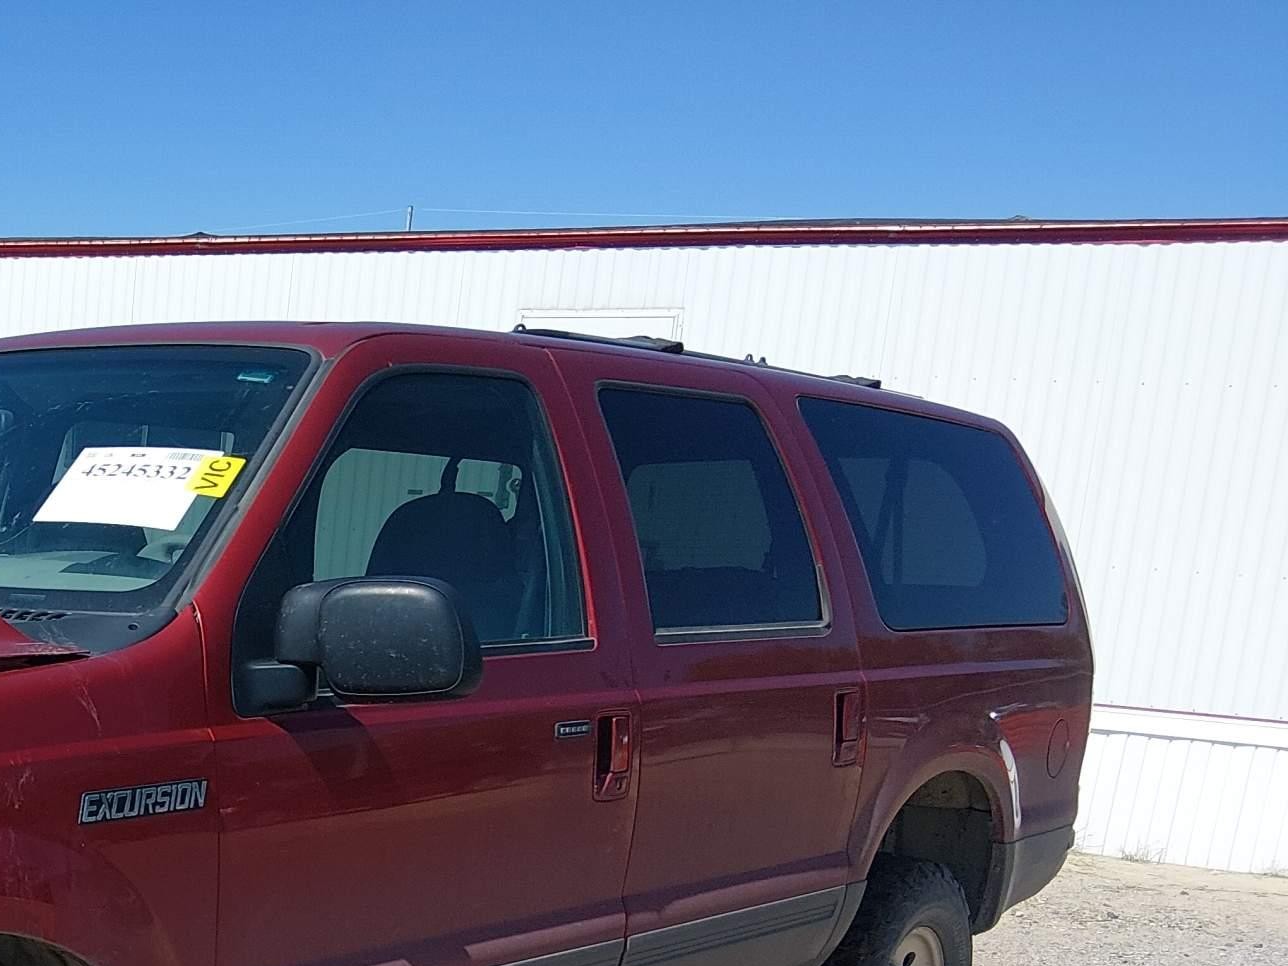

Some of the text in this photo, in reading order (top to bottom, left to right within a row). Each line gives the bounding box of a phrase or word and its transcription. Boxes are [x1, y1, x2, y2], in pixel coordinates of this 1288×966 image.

[82, 463, 192, 480] 45245332
[193, 460, 232, 491] VIC
[82, 780, 207, 823] EXCURSION
